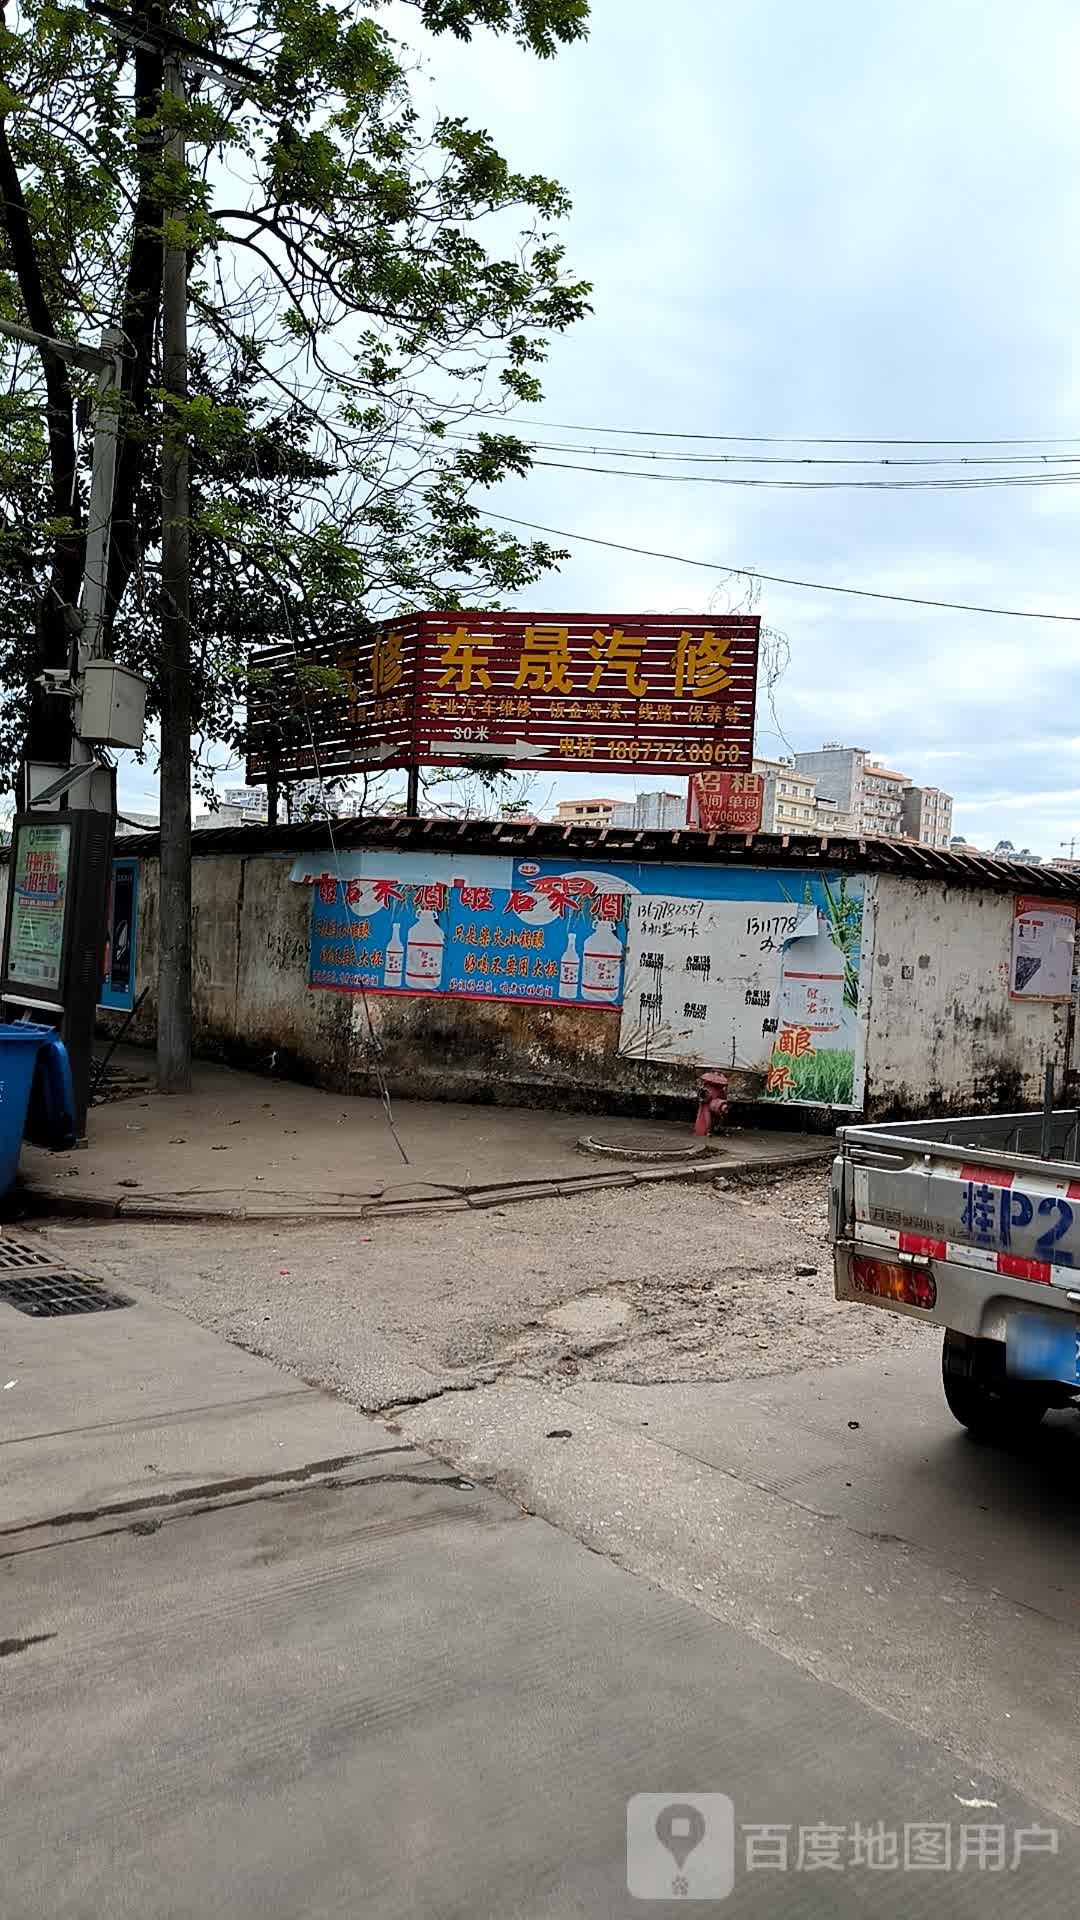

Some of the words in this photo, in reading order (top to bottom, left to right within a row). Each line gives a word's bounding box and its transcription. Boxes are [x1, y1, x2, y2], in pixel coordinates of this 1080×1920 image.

[436, 626, 735, 698] 东晟汽修
[453, 725, 490, 742] 30米
[559, 736, 597, 759] 电话
[696, 771, 760, 793] 招租
[728, 795, 760, 810] 单间
